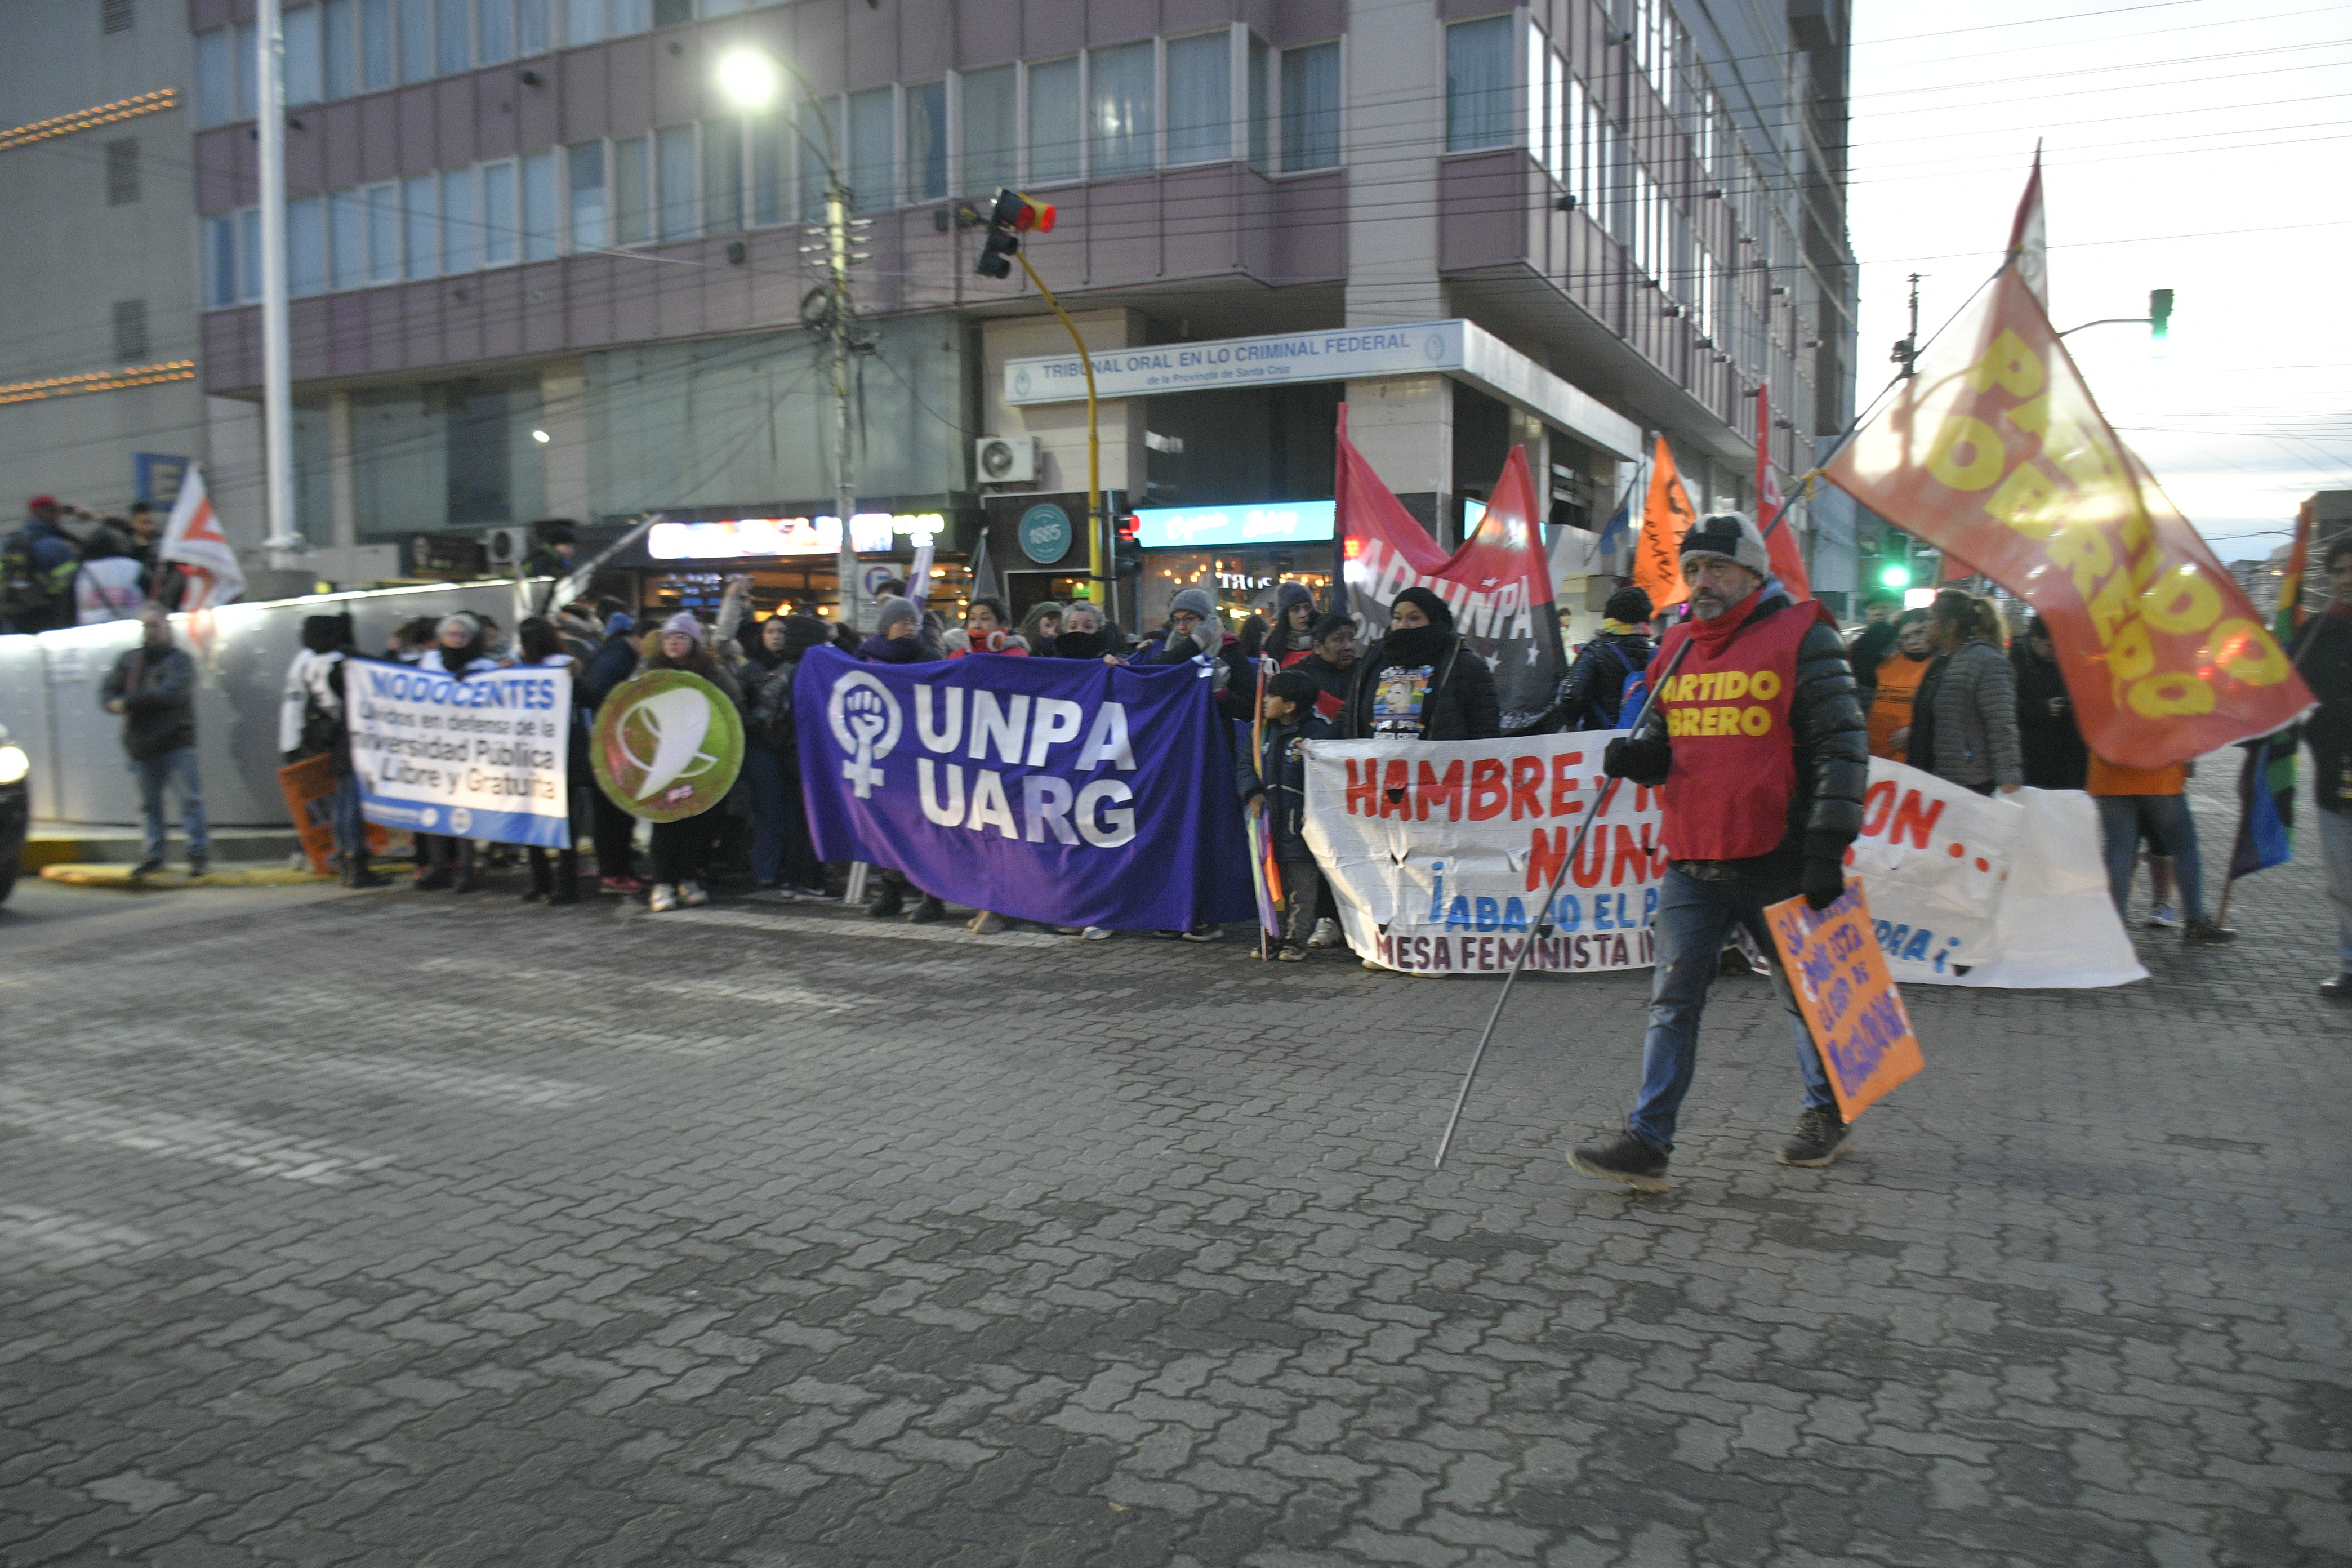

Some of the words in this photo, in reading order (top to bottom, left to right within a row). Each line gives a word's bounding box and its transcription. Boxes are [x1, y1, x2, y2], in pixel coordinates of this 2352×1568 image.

[1127, 354, 1174, 372] ORAL
[1179, 350, 1202, 367] EN
[1206, 348, 1230, 364] LO
[1235, 340, 1321, 362] CRIMINAL
[1325, 332, 1412, 354] FEDERAL
[1147, 376, 1160, 385] de
[1173, 371, 1219, 382] Provincia
[1220, 369, 1233, 379] de
[1237, 367, 1265, 377] Santa
[1268, 365, 1291, 375] Cruz
[369, 670, 554, 710] NODOCENTES
[914, 683, 1137, 771] UNPA
[1666, 705, 1772, 737] BRERO
[380, 757, 439, 788] Libre
[447, 772, 462, 795] y
[468, 767, 555, 800] Gratuita
[1345, 751, 1584, 822] HAMBRE
[916, 758, 1137, 848] UARG
[1594, 892, 1636, 931] EL
[1375, 930, 1451, 970] MESA
[1462, 932, 1630, 970] FEMINISTA
